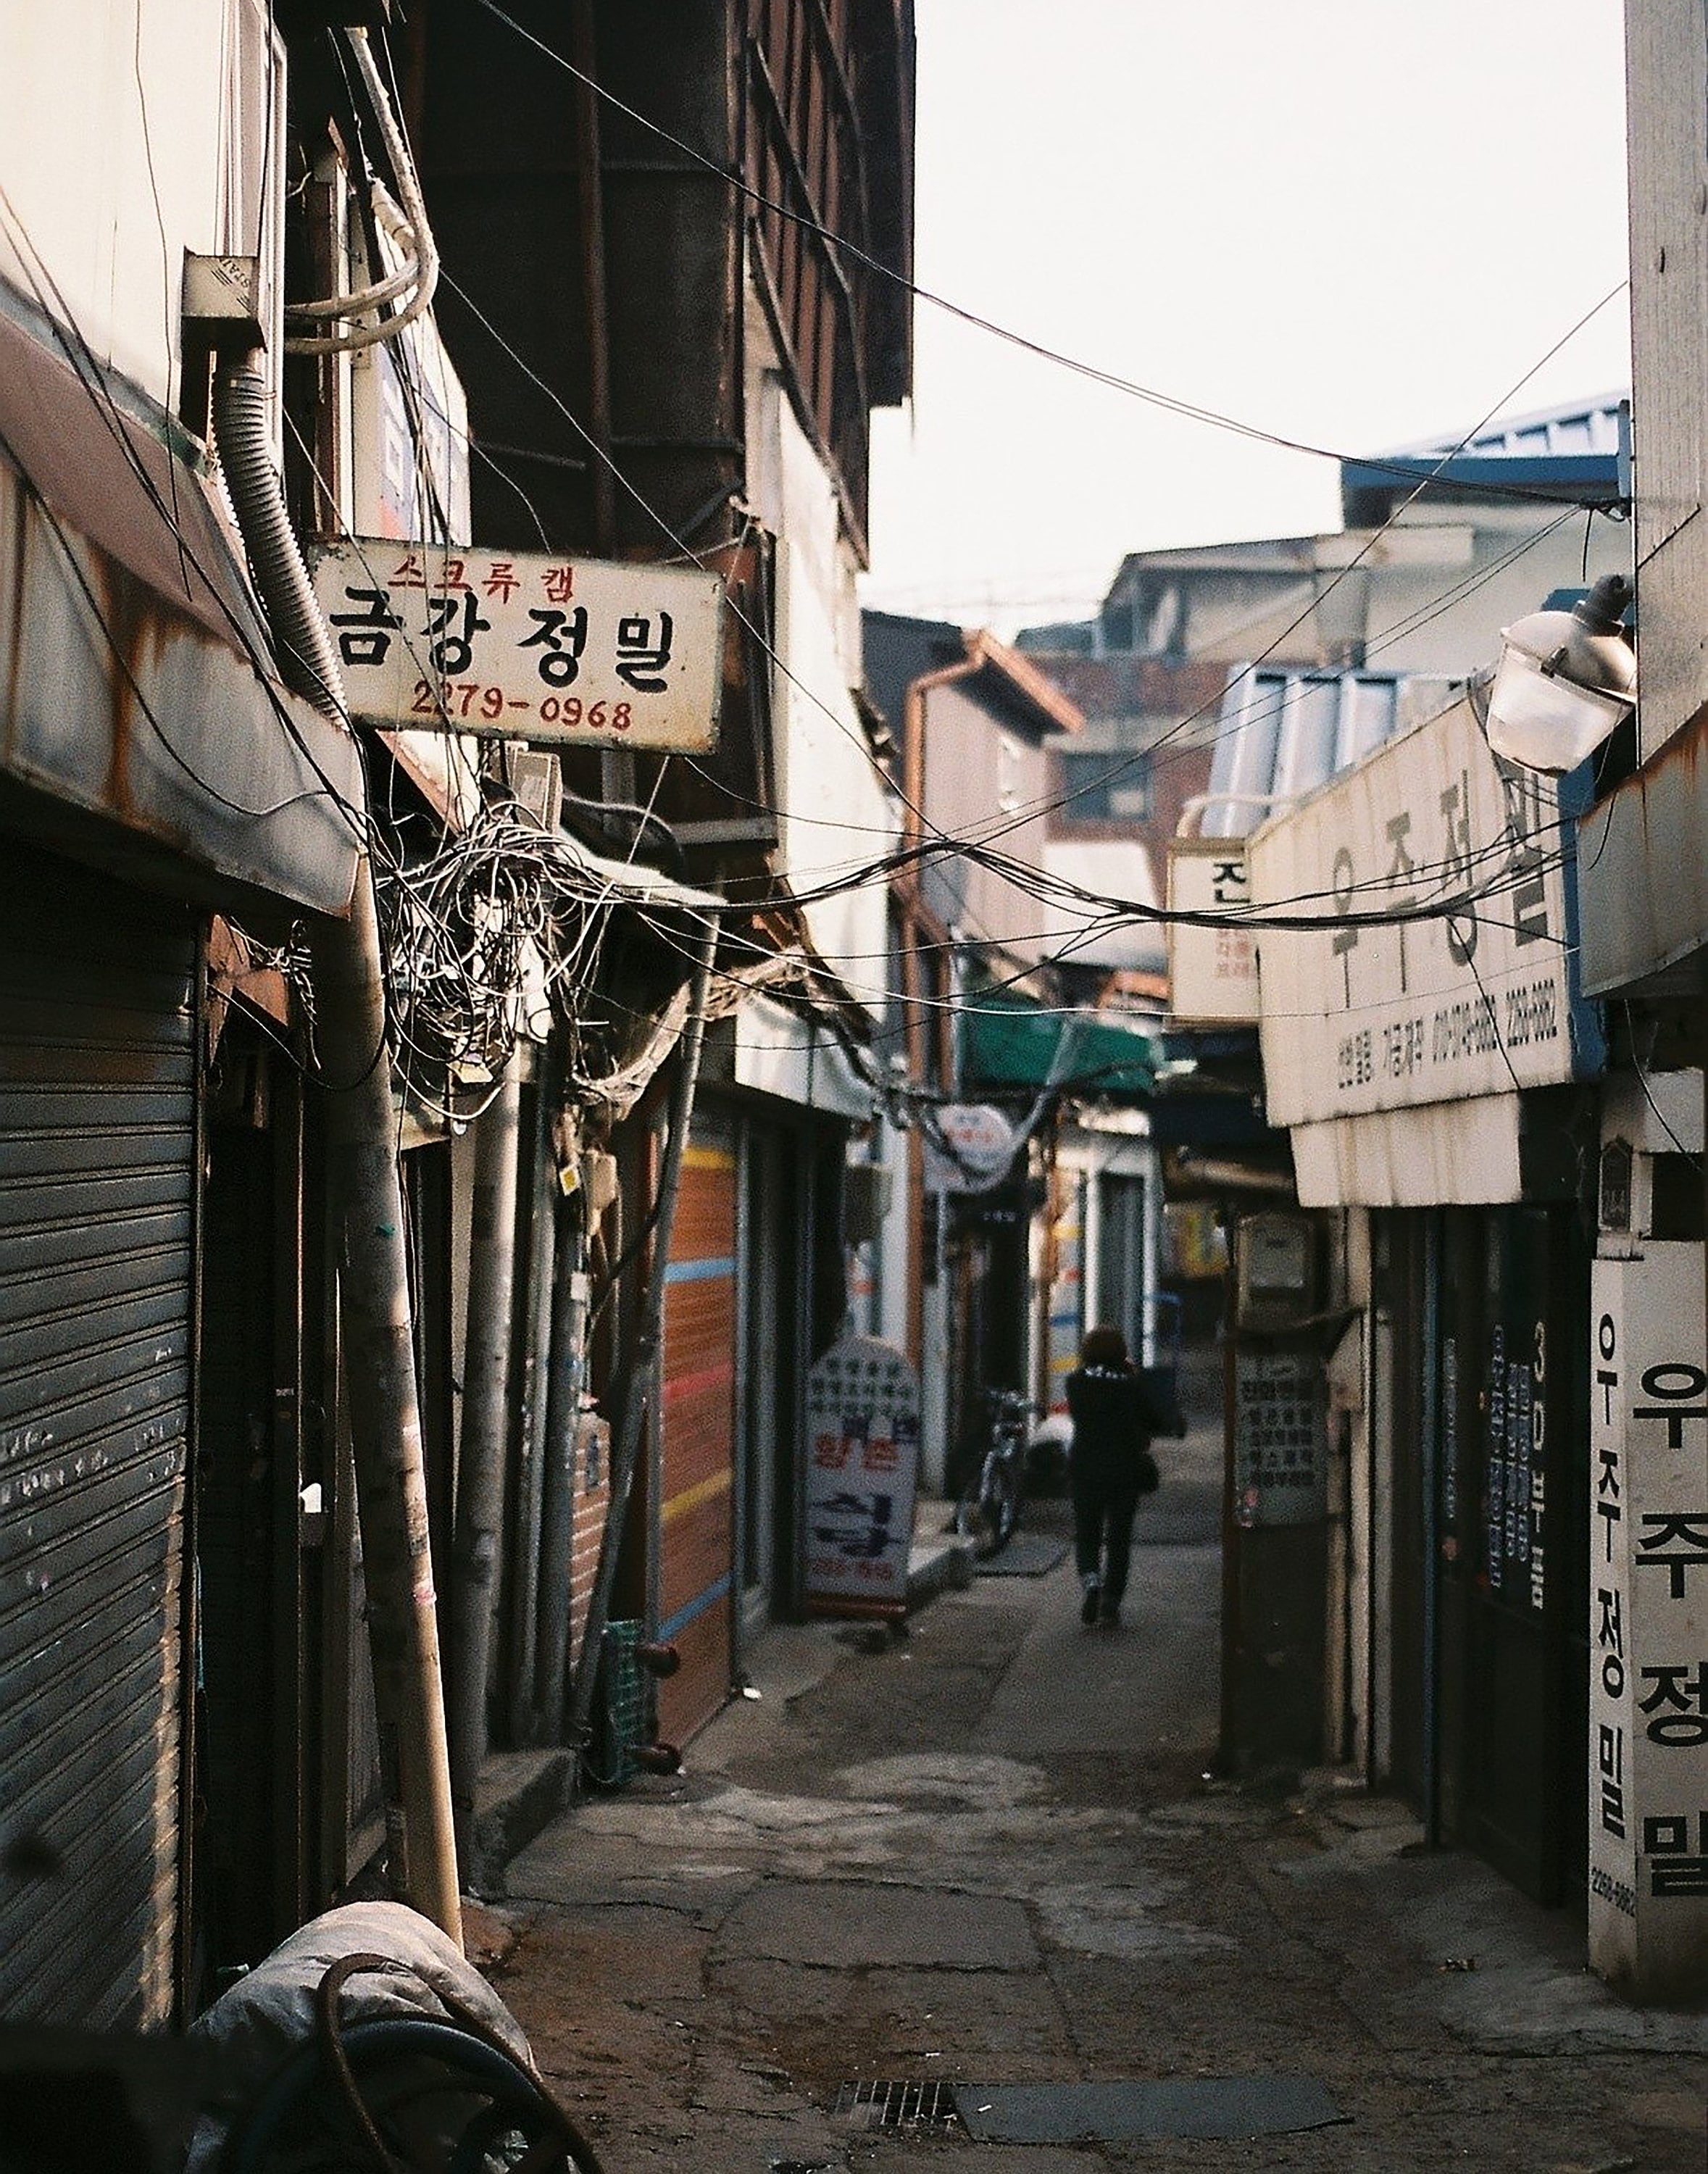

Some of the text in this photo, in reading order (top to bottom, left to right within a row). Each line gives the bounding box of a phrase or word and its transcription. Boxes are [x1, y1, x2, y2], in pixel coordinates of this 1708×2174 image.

[388, 557, 521, 604] 스크류
[410, 679, 633, 731] 2279-0968
[1331, 751, 1549, 1009] 우주정밀
[1597, 1313, 1625, 1839] 우주정밀
[1633, 1363, 1708, 1896] 우주정밀
